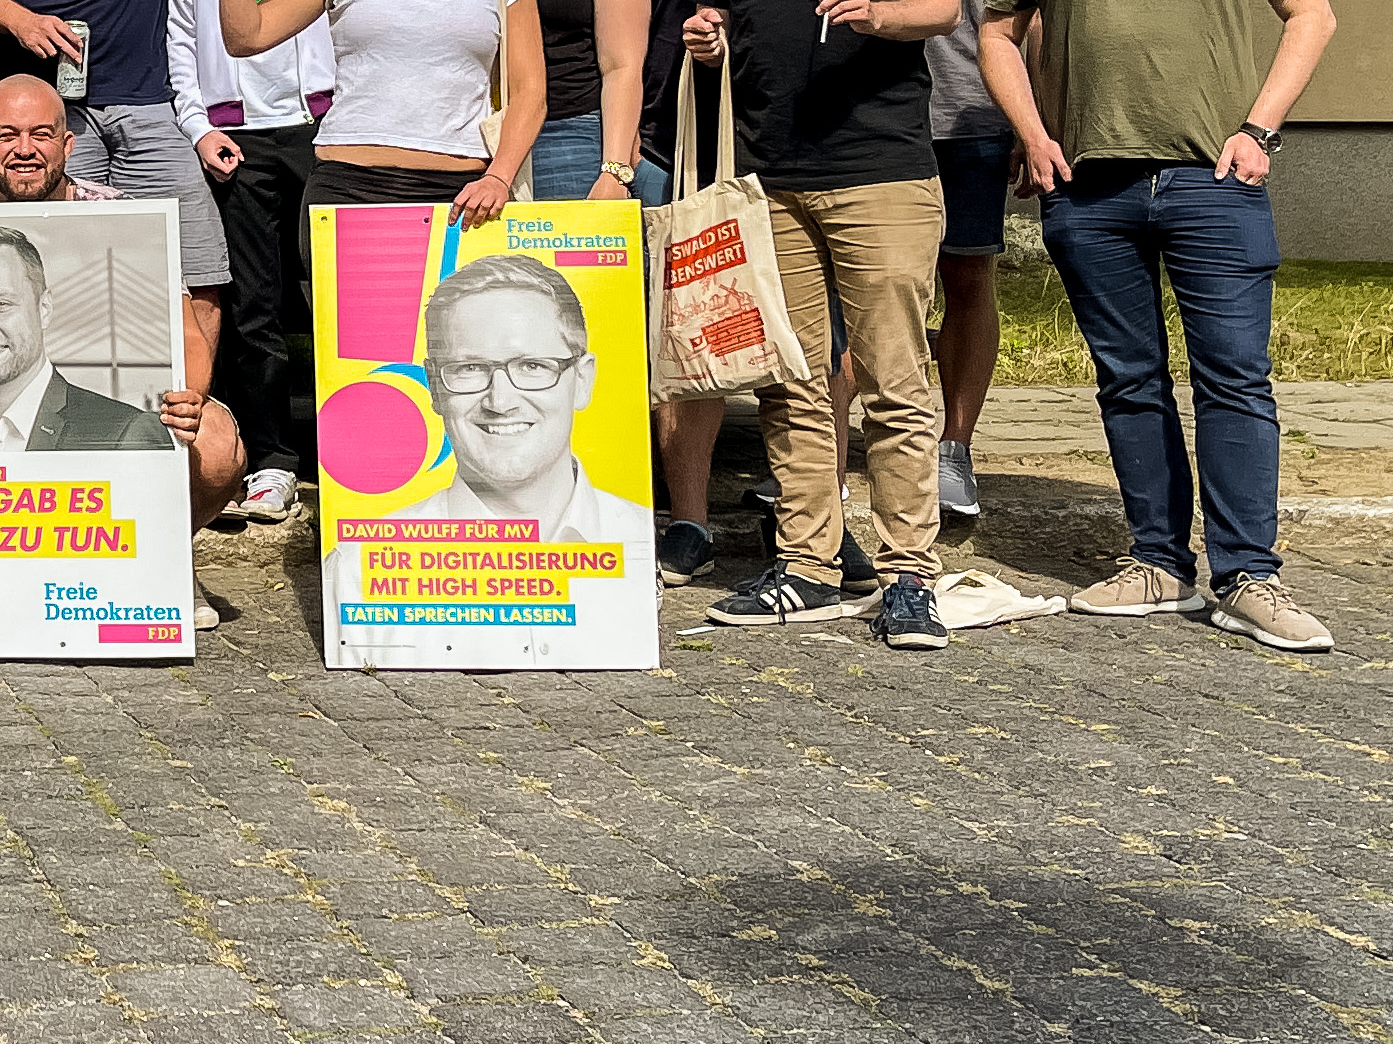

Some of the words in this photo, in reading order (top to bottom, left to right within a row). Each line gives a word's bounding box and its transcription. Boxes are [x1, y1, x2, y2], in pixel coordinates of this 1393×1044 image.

[506, 217, 553, 233] Freie
[717, 222, 737, 242] IST
[507, 233, 627, 249] Demokraten
[597, 252, 625, 264] FDP
[68, 487, 104, 513] ES
[54, 526, 129, 552] TUN.
[341, 523, 397, 539] DAVID
[400, 523, 459, 539] WULFF
[465, 520, 498, 539] FÜR
[503, 523, 534, 539] MV
[368, 546, 412, 570] FÜR
[420, 551, 617, 571] DIGITALISIERUNG
[44, 582, 98, 601] Freie
[369, 577, 409, 596] MIT
[417, 577, 478, 596] HIGH
[486, 577, 562, 596] SPEED.
[45, 602, 182, 621] Demokraten
[344, 606, 399, 622] TATEN
[404, 606, 494, 623] SPRECHEN
[500, 607, 573, 623] LASSEN.
[147, 627, 179, 640] FDP
